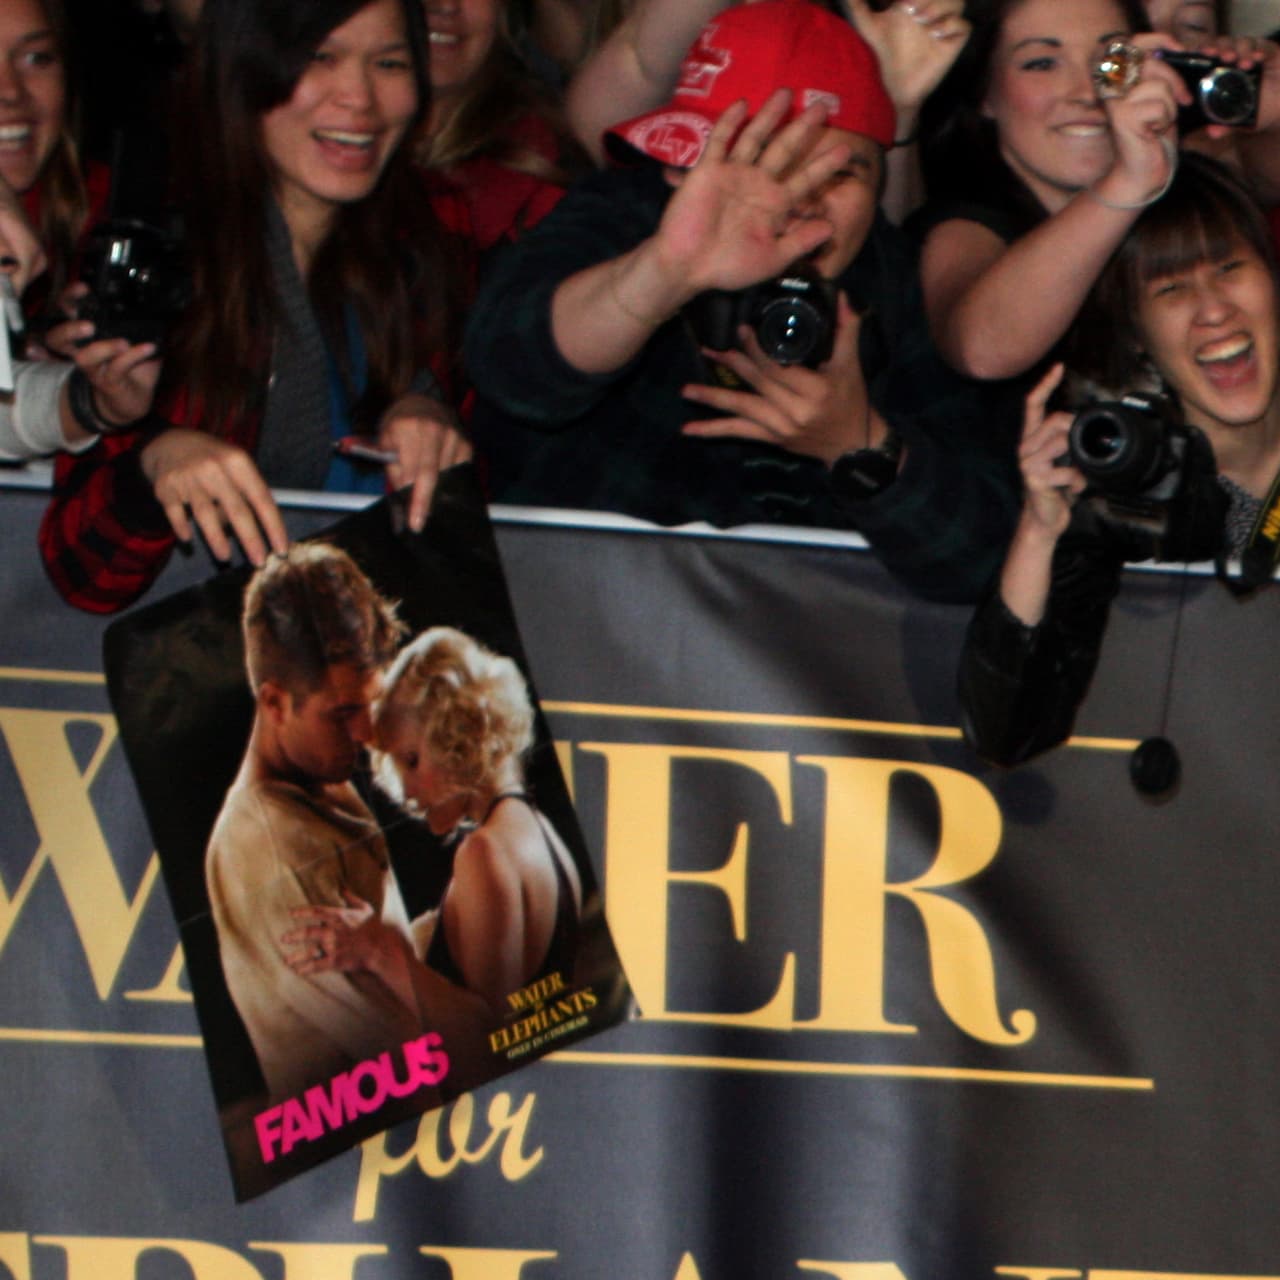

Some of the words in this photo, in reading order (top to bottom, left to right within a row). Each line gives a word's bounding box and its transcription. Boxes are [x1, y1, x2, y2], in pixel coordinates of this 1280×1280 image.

[0, 708, 1037, 1046] WER
[488, 987, 598, 1053] ELEPHANTS
[506, 971, 564, 1010] WATER
[254, 1032, 449, 1164] FAMOUS
